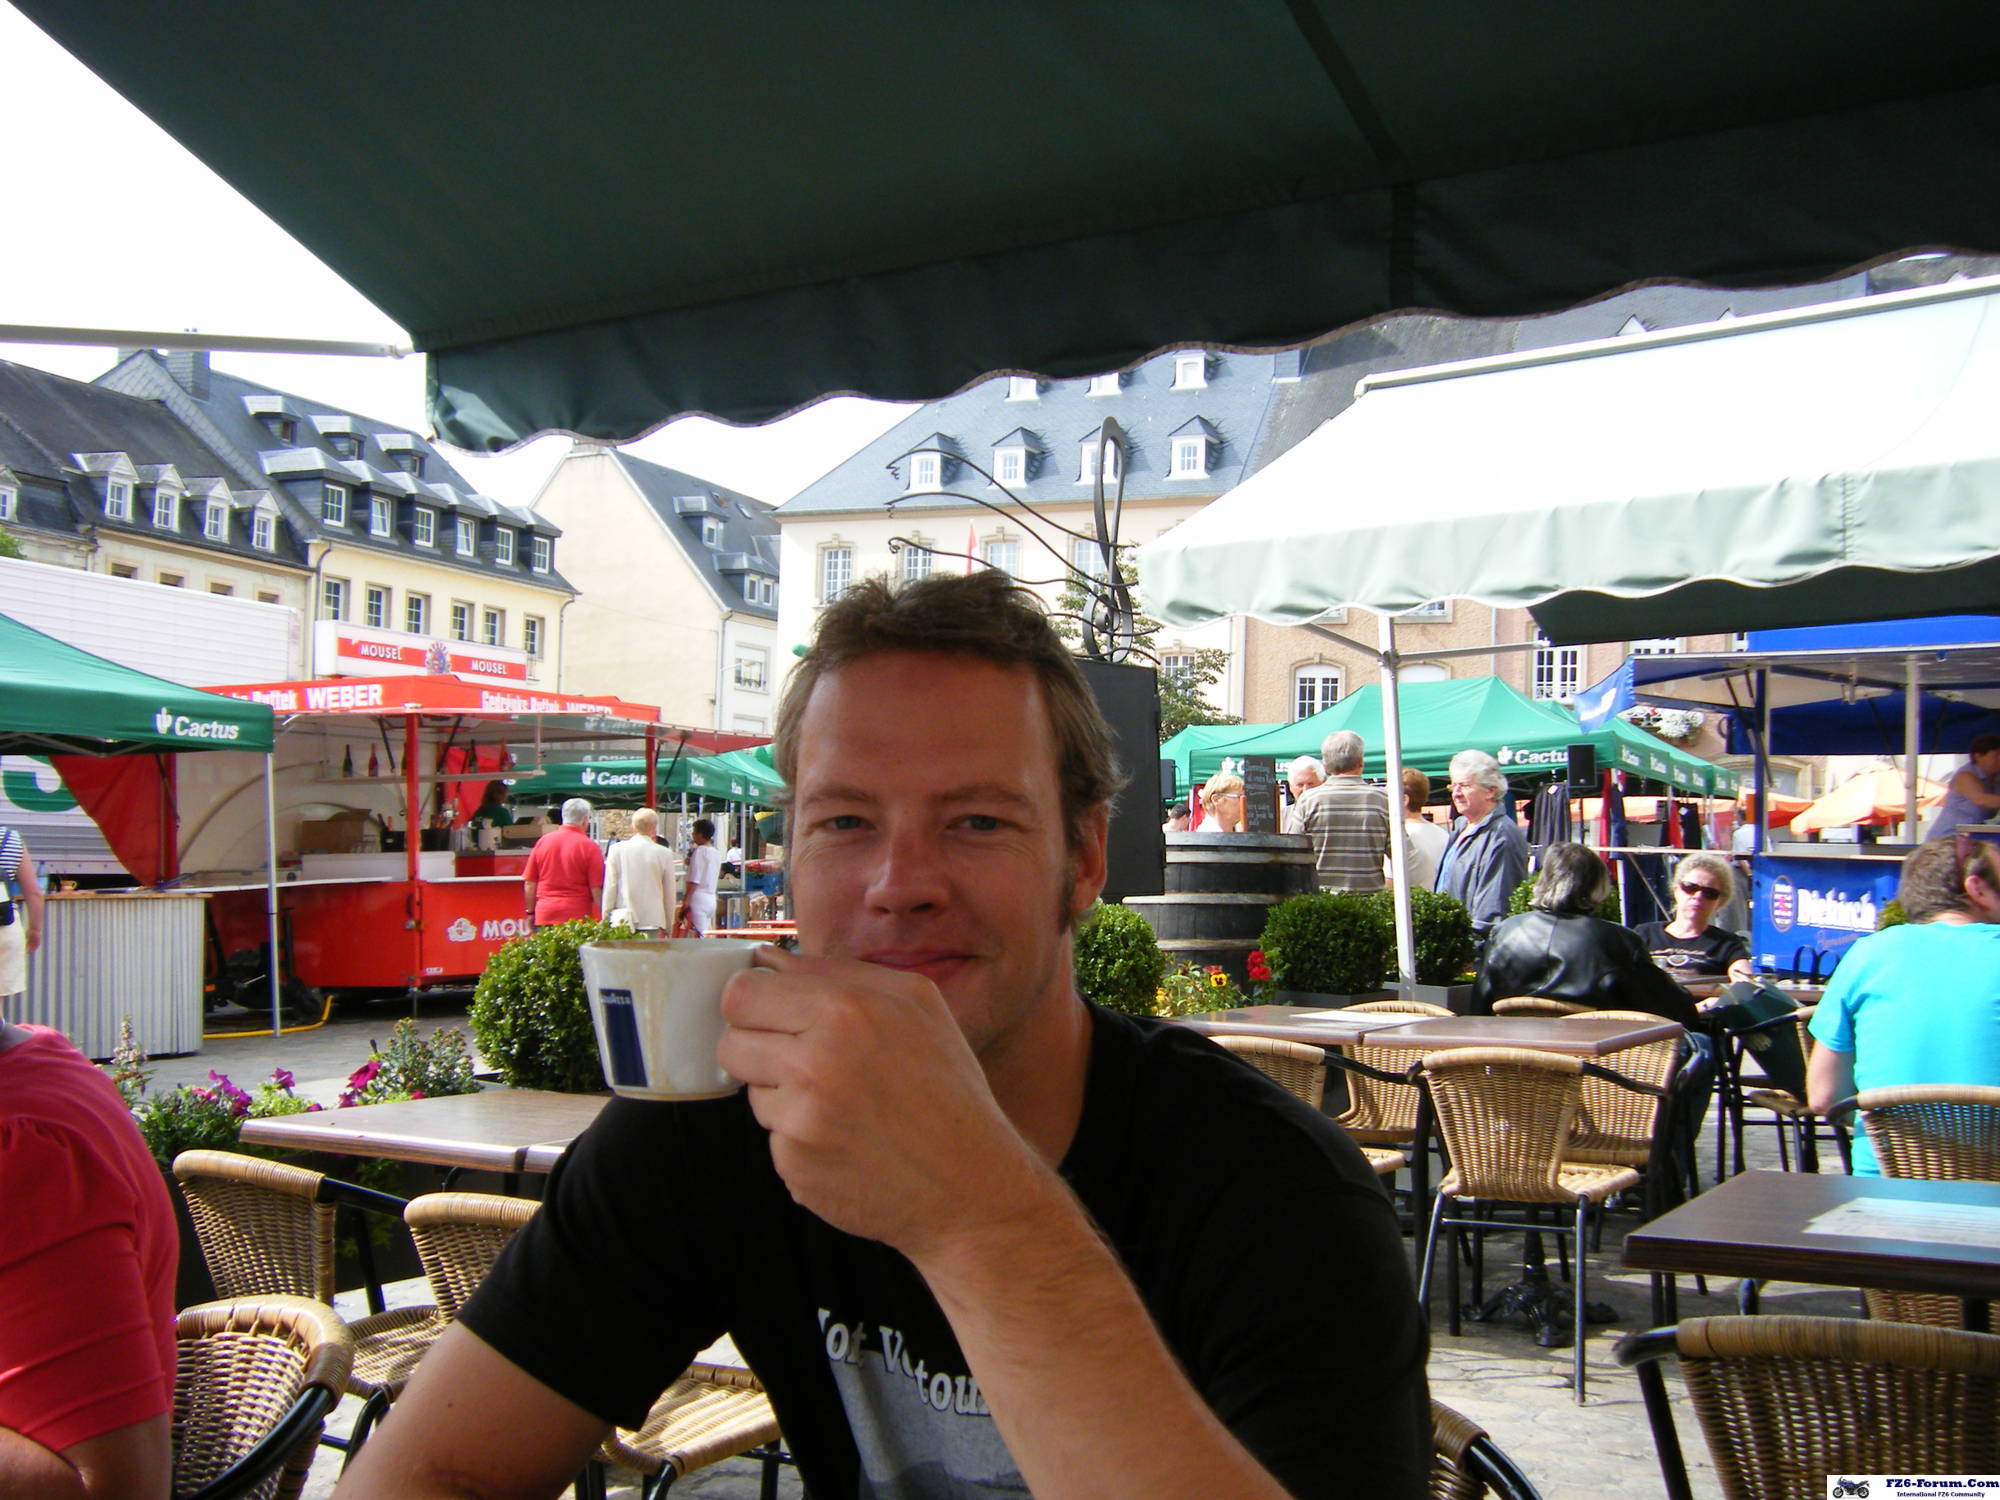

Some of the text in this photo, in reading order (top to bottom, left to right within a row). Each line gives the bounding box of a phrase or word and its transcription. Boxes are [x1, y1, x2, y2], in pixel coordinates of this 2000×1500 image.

[360, 643, 403, 661] MOUSEL
[471, 659, 508, 675] MOUSEL
[305, 683, 383, 710] WEBER
[174, 715, 240, 740] Cactus
[1514, 749, 1568, 764] Cactu
[596, 771, 647, 786] Cactu
[481, 918, 531, 938] MOU
